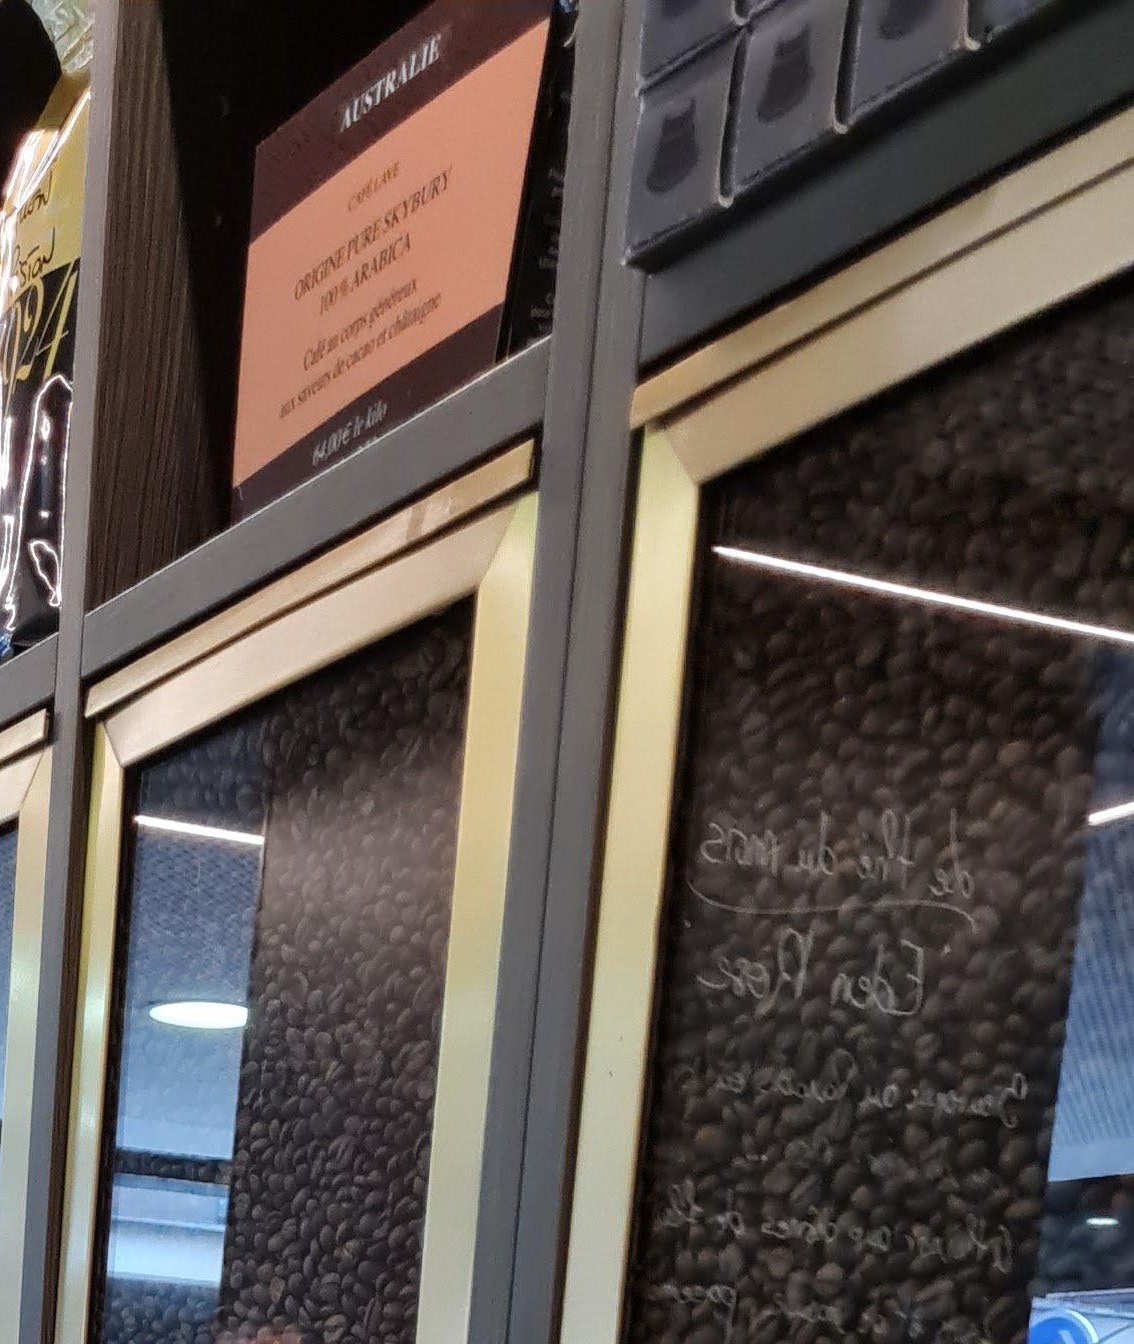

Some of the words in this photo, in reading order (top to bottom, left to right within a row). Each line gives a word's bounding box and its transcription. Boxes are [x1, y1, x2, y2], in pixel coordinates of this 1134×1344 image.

[340, 33, 442, 133] AUSTRALIE
[294, 246, 345, 301] ORIGINE
[346, 219, 381, 260] PURE
[383, 165, 454, 233] SKYBURY
[351, 233, 411, 292] ARABICA
[332, 357, 345, 379] de
